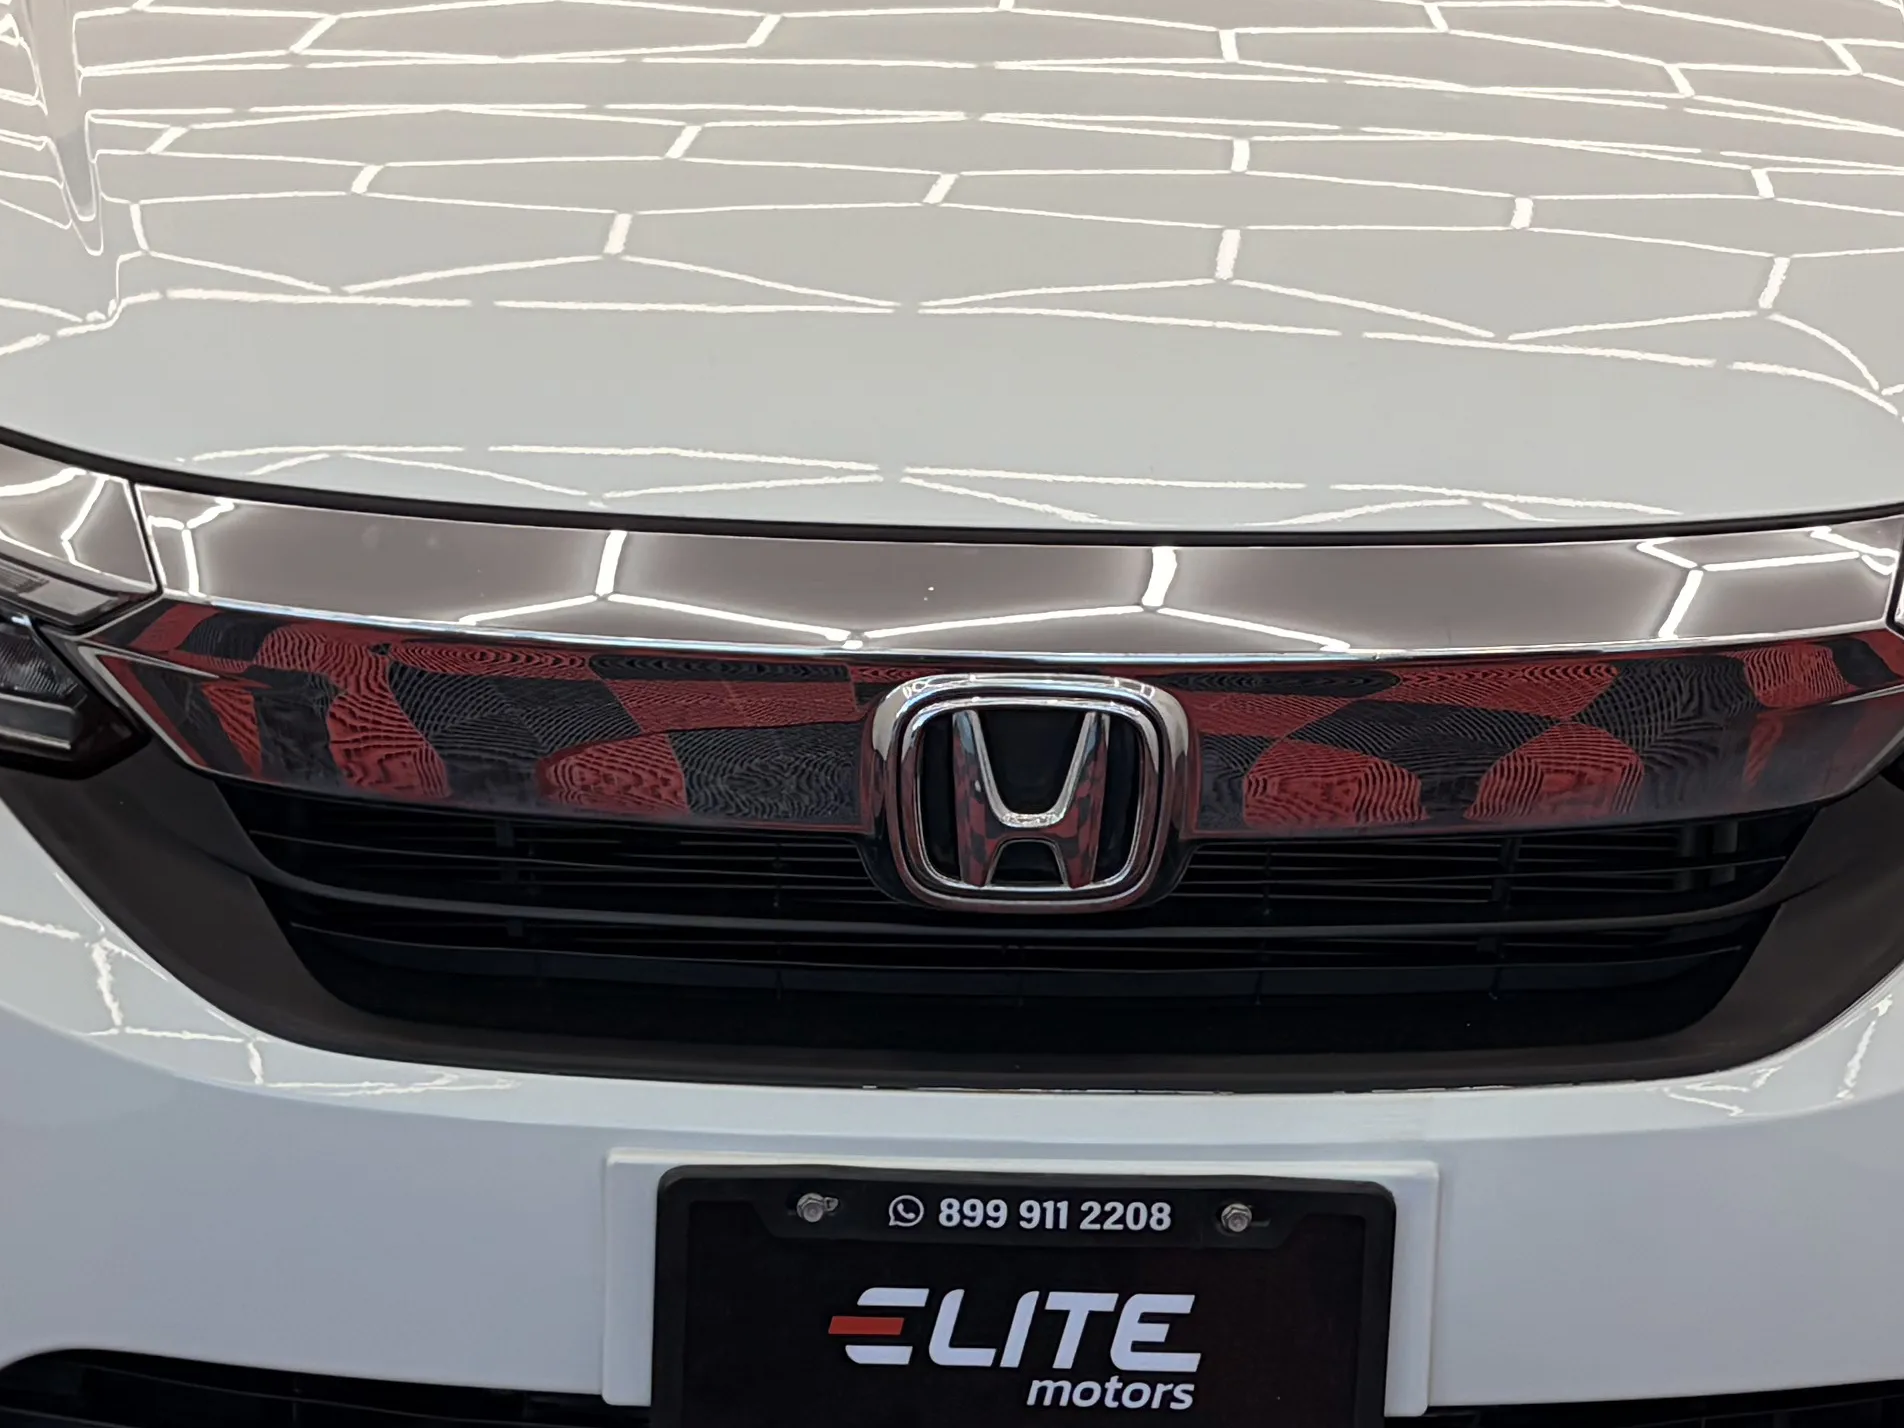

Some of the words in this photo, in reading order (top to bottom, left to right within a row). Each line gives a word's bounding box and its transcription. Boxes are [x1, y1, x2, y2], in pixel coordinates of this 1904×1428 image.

[939, 1199, 1007, 1228] 899
[1020, 1200, 1068, 1228] 911
[1080, 1201, 1170, 1230] 2208
[828, 1287, 1202, 1372] ELITE
[1027, 1376, 1194, 1409] motors
